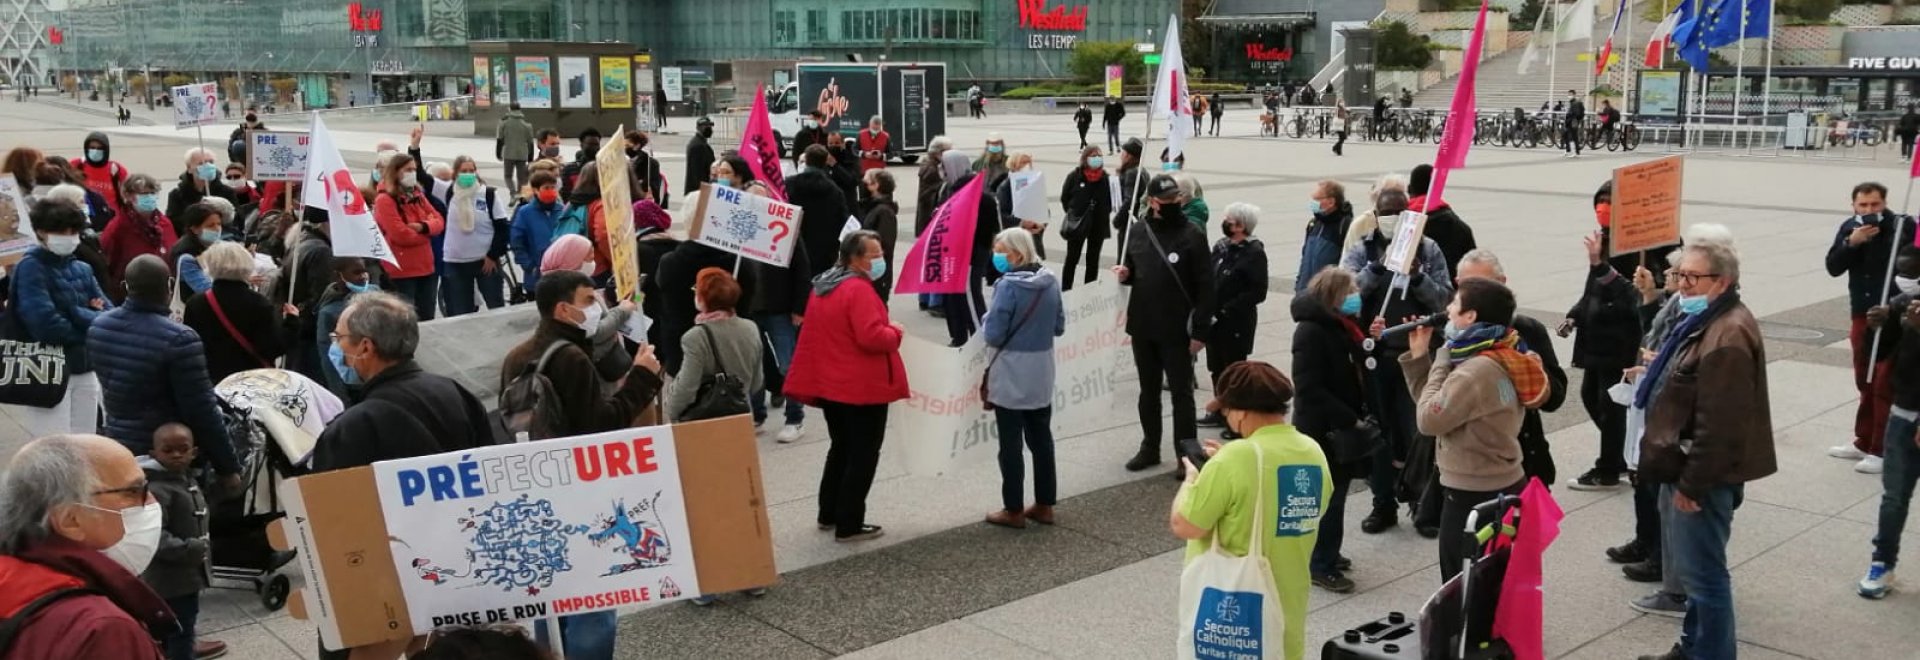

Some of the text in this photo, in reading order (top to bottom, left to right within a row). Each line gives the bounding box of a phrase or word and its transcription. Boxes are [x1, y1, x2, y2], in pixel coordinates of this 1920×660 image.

[1017, 0, 1088, 31] Westfield
[1028, 34, 1042, 49] LES
[1051, 35, 1077, 49] TEMPS
[1849, 57, 1885, 69] FIVE
[206, 95, 216, 115] ?
[768, 203, 793, 219] URE
[767, 220, 790, 252] ?
[397, 437, 659, 507] PRÉFECTURE
[1287, 495, 1316, 506] Secours
[486, 607, 510, 624] DE
[514, 602, 547, 620] RDV
[552, 587, 650, 614] IMPOSSIBLE
[1204, 618, 1250, 637] Secours
[1197, 629, 1258, 651] Catholique
[1197, 645, 1226, 658] Caritas
